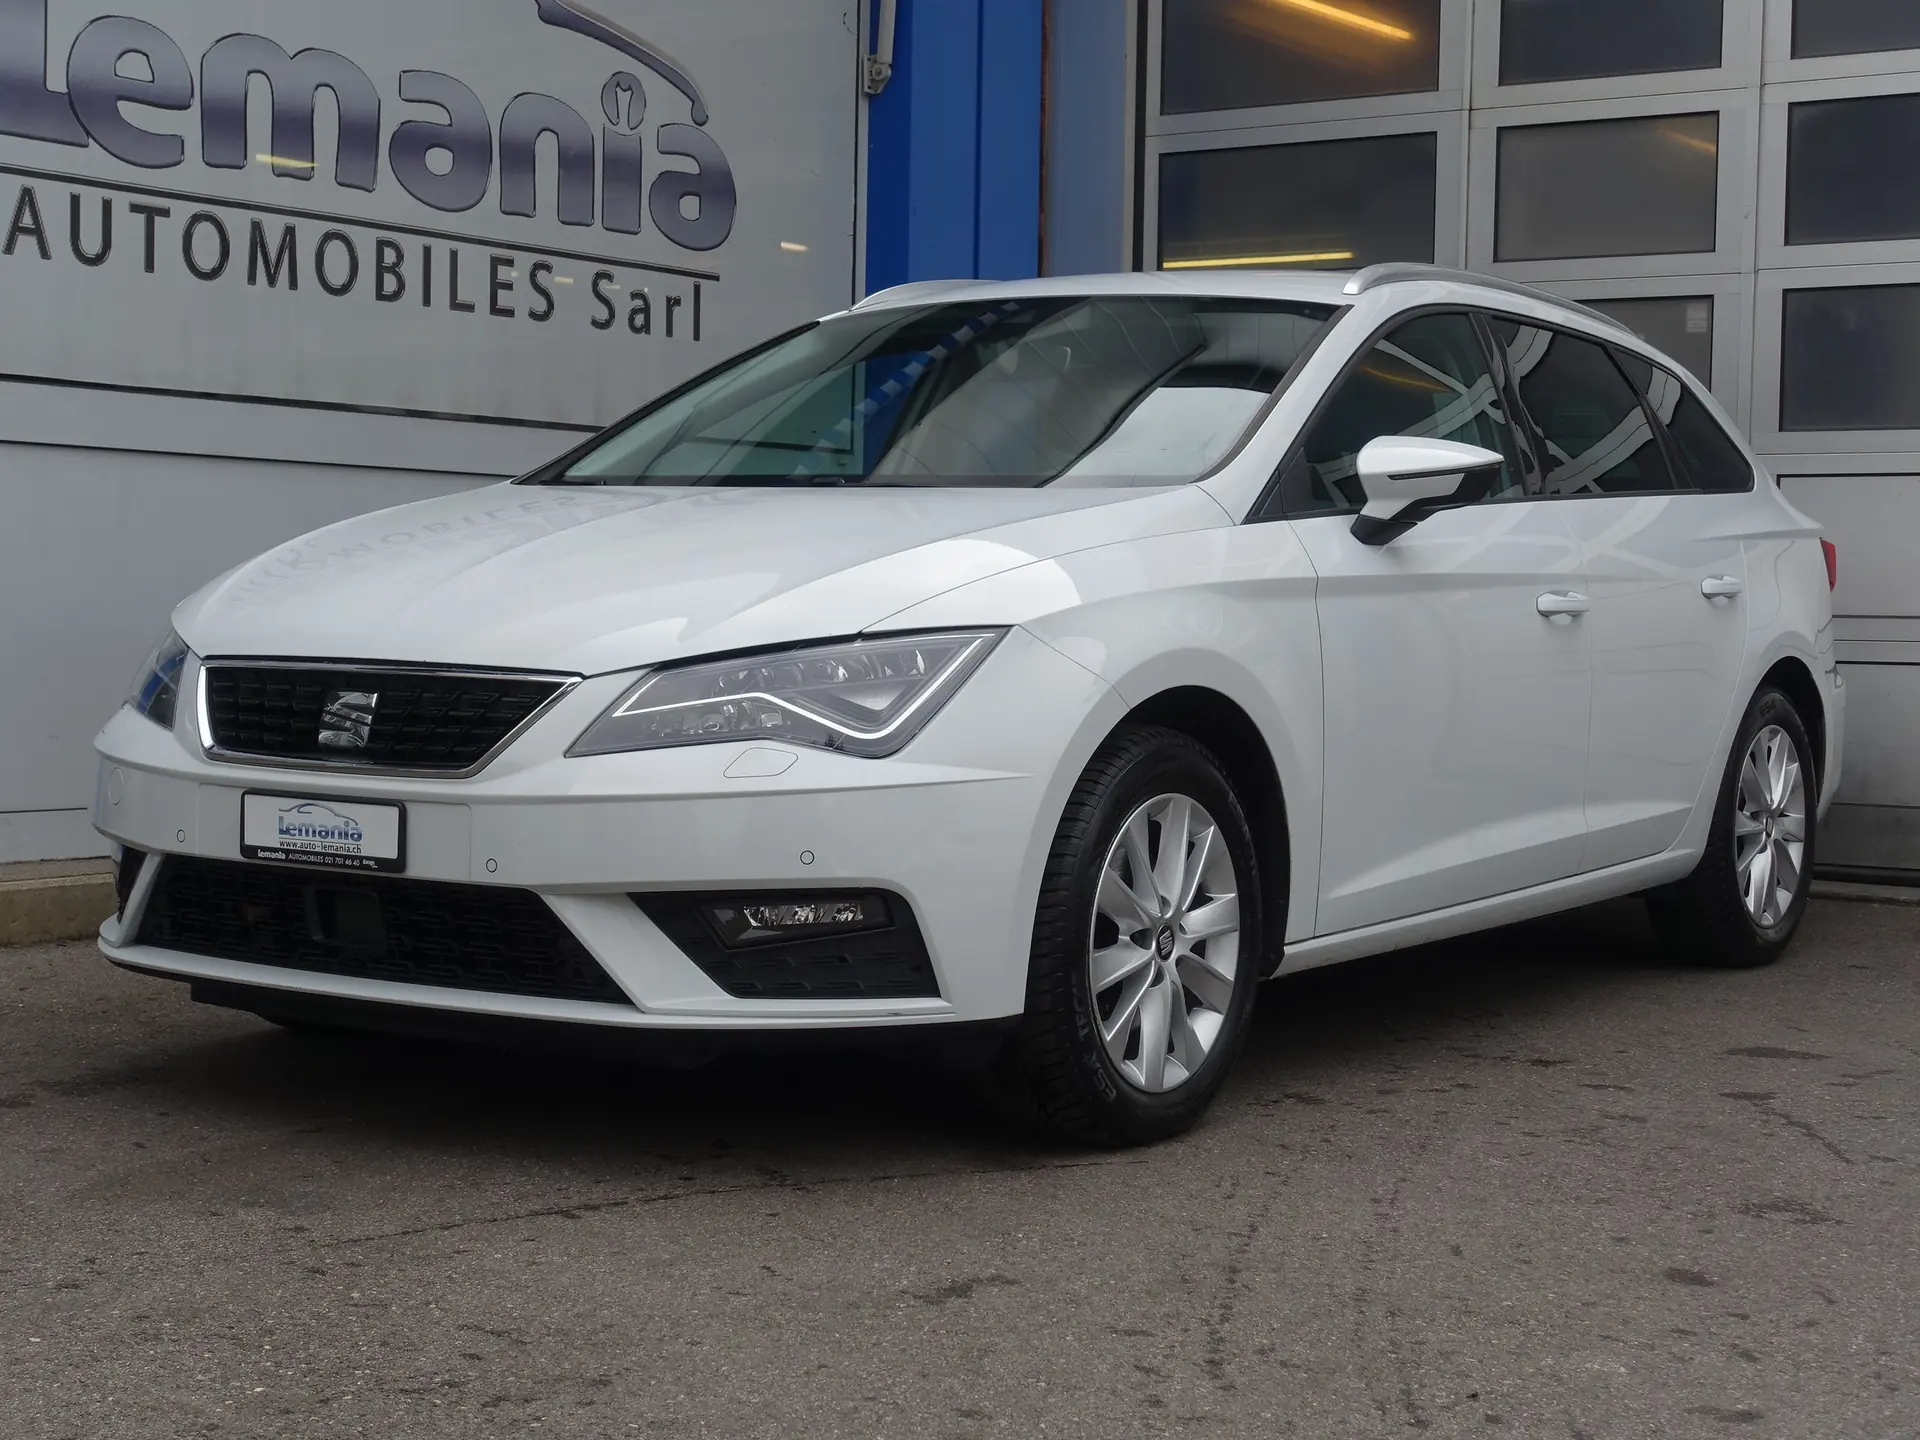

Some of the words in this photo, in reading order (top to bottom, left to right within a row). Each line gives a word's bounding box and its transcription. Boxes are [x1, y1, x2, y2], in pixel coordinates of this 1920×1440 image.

[2, 184, 558, 323] AUTOMOBILES
[590, 270, 702, 342] Sarl
[279, 816, 362, 842] Lemania
[279, 841, 362, 854] www.auto-lemania.ch
[288, 853, 323, 863] AUTOMOBILES
[325, 856, 333, 864] 021
[335, 857, 343, 865] 701
